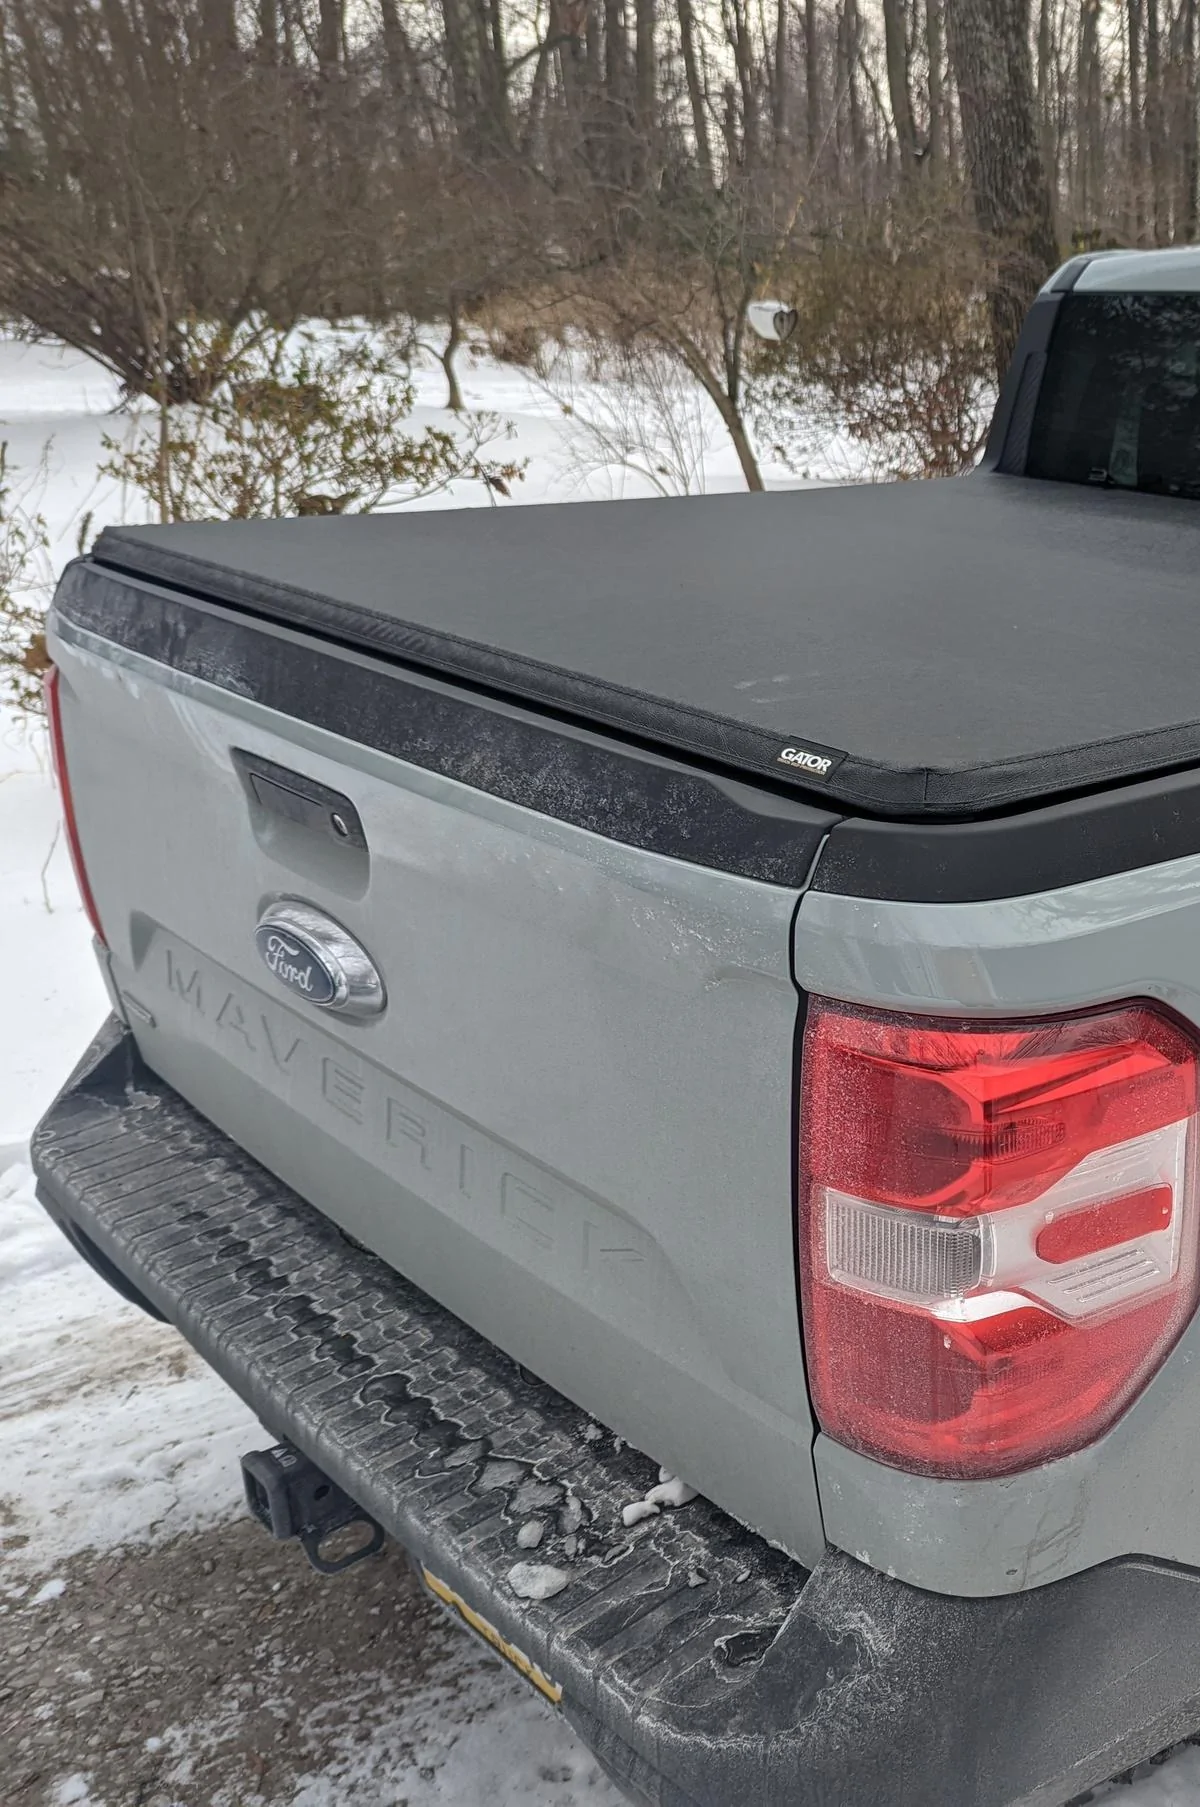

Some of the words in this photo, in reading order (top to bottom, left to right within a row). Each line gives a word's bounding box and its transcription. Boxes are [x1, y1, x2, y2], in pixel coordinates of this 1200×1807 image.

[781, 748, 832, 772] GATOR
[265, 935, 314, 992] Ford
[164, 948, 648, 1275] MAVERICK
